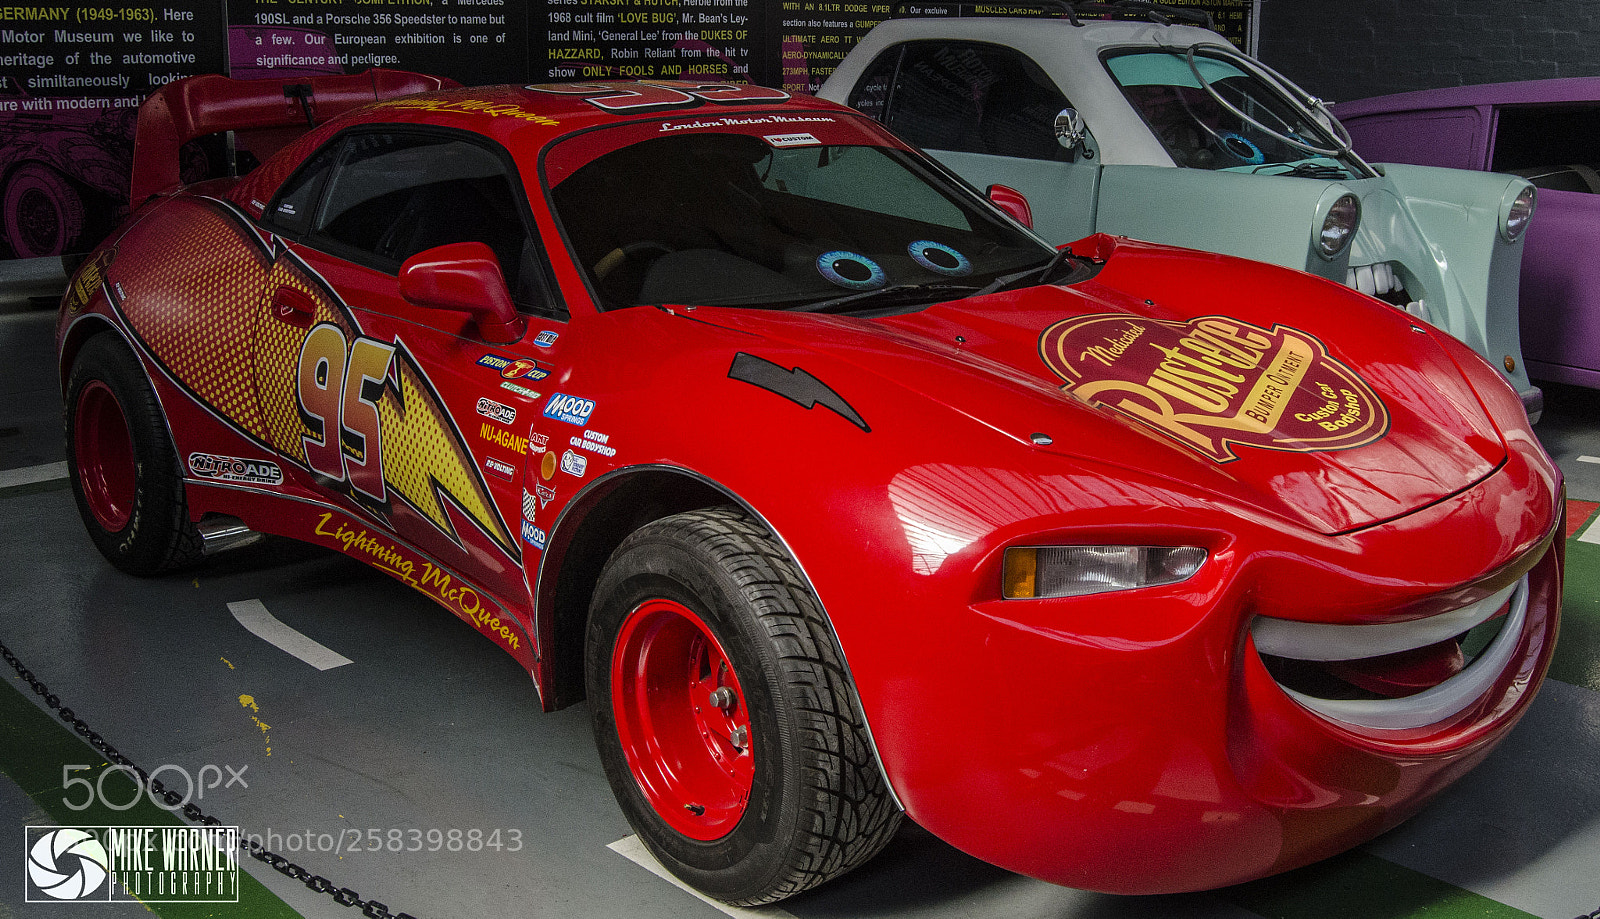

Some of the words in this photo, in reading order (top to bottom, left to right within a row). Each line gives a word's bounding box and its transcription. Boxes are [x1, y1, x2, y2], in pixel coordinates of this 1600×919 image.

[0, 7, 70, 21] ERMANY
[76, 8, 158, 23] (1949-1963).
[163, 9, 194, 21] Here
[783, 3, 800, 11] WITH
[804, 3, 815, 11] AN
[844, 4, 868, 13] DODGE
[871, 5, 890, 13] VIPER
[910, 6, 921, 14] Our
[254, 13, 290, 25] 190SL
[292, 13, 314, 25] and
[316, 16, 323, 25] a
[325, 13, 371, 25] Porsche
[373, 14, 392, 24] 356
[394, 13, 446, 27] Speedster
[447, 15, 458, 25] to
[460, 17, 487, 25] name
[489, 14, 505, 25] but
[548, 13, 572, 23] 1968
[574, 13, 594, 23] cult
[596, 12, 615, 23] film
[682, 13, 696, 23] Mr.
[730, 13, 749, 25] Ley-
[782, 19, 806, 27] section
[808, 19, 821, 27] also
[823, 20, 848, 28] features
[2, 30, 45, 43] Motor
[54, 30, 114, 43] Museum
[123, 33, 143, 43] we
[151, 30, 174, 43] like
[182, 31, 195, 43] to
[255, 37, 263, 46] a
[271, 34, 296, 46] few.
[304, 34, 326, 46] Our
[334, 33, 387, 47] European
[394, 33, 445, 44] exhibition
[453, 33, 462, 44] is
[469, 36, 488, 44] one
[495, 33, 506, 44] of
[548, 31, 570, 41] land
[572, 31, 597, 42] Mini,
[661, 30, 683, 41] from
[684, 30, 699, 40] the
[701, 30, 733, 40] DUKES
[735, 30, 748, 40] OF
[782, 35, 816, 43] ULTIMATE
[820, 36, 840, 44] AERO
[65, 52, 80, 65] of
[90, 52, 112, 65] the
[122, 52, 196, 65] automotive
[548, 49, 604, 60] HAZZARD,
[611, 48, 639, 59] Robin
[644, 47, 676, 58] Reliant
[681, 47, 701, 58] from
[706, 47, 720, 58] the
[725, 46, 736, 57] hit
[740, 47, 749, 57] tv
[256, 54, 325, 69] significance
[327, 53, 348, 65] and
[351, 53, 401, 67] pedigree.
[548, 67, 576, 78] show
[583, 66, 612, 76] ONLY
[619, 65, 654, 76] FOOLS
[660, 65, 682, 75] AND
[688, 64, 728, 74] HORSES
[733, 63, 749, 74] and
[149, 74, 195, 86] looki
[22, 98, 53, 111] with
[57, 97, 110, 110] modern
[114, 97, 139, 108] and
[659, 120, 723, 132] London
[720, 117, 772, 125] Motor
[769, 115, 836, 123] Museum
[782, 135, 813, 143] CUSTOM
[1080, 320, 1146, 367] Medicated
[479, 355, 510, 369] PISTON
[527, 369, 547, 379] CUP
[1315, 381, 1338, 400] Car
[544, 393, 594, 418] MOOD
[1245, 384, 1284, 424] BUMPER
[297, 322, 397, 504] 95
[561, 413, 585, 426] SPRINGS
[583, 429, 610, 445] CUSTOM
[569, 436, 583, 448] CAR
[581, 439, 617, 457] BODYSHOP
[315, 512, 419, 588] Lightning
[421, 562, 520, 650] McQueen
